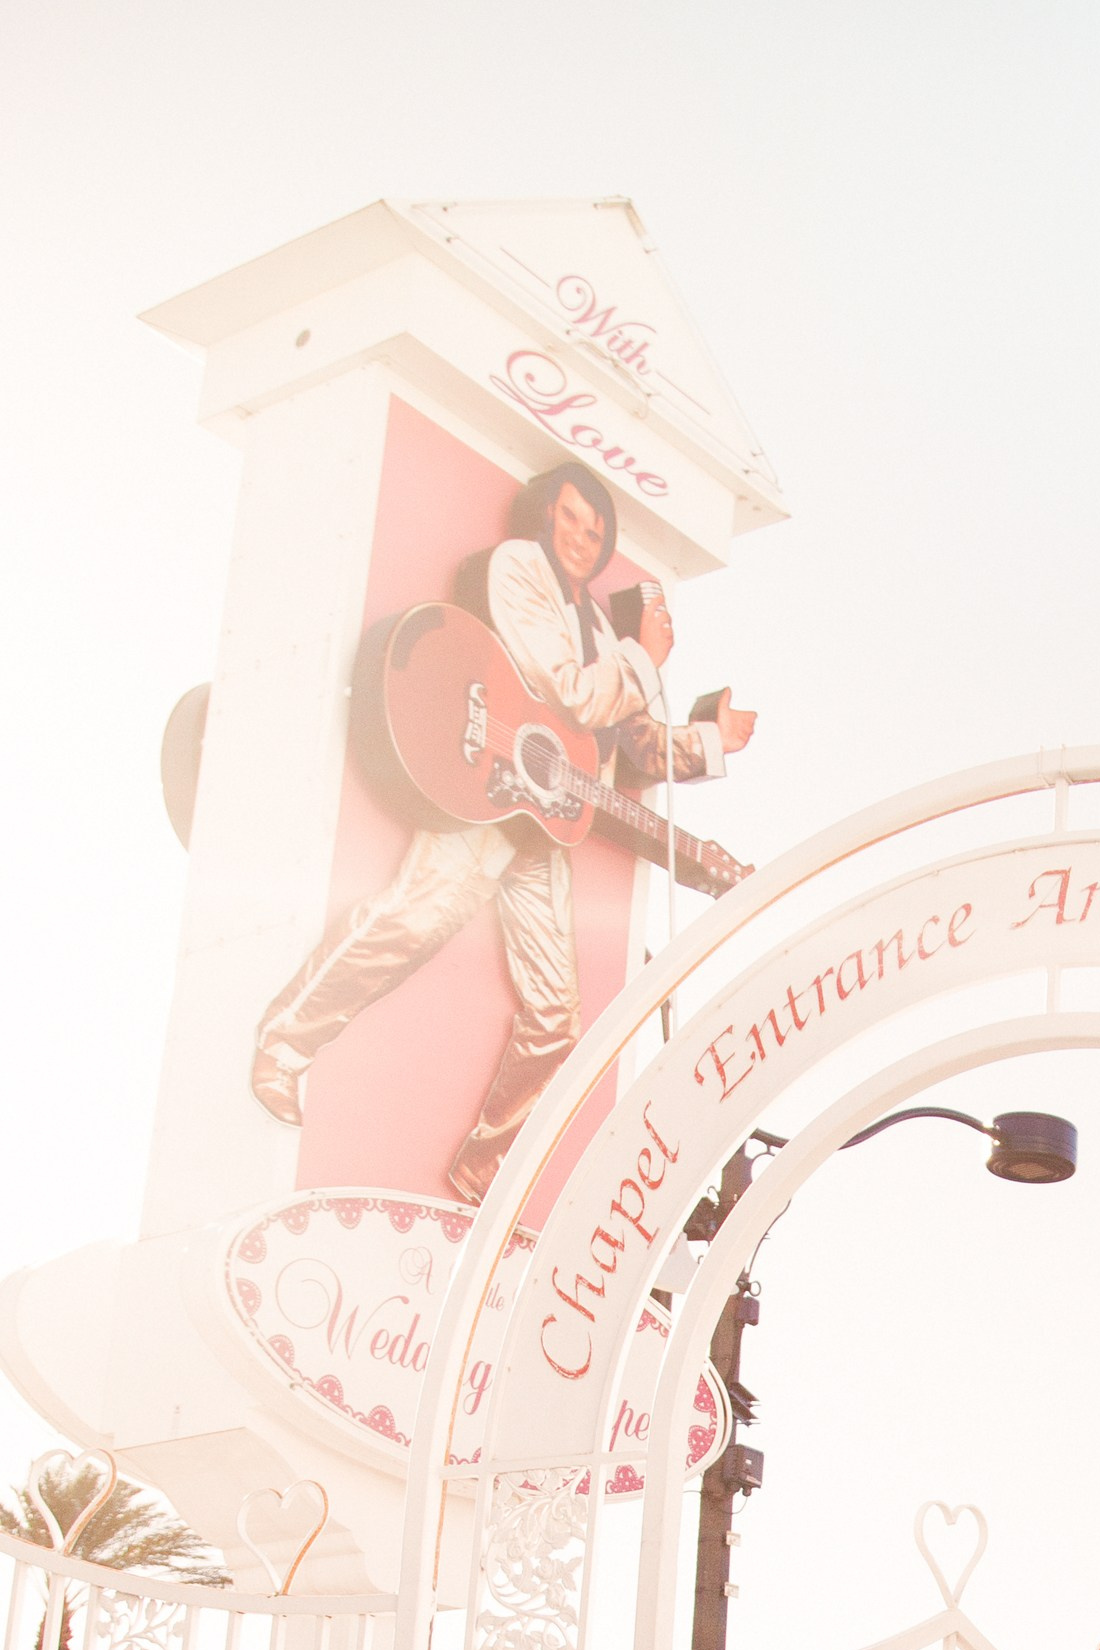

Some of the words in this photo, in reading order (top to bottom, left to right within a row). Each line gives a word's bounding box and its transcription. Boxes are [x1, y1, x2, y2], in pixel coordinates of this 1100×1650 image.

[556, 274, 657, 377] With
[489, 350, 669, 498] Love
[540, 1099, 681, 1381] Chapel
[693, 902, 978, 1104] Entrance
[275, 1257, 493, 1416] Weddg
